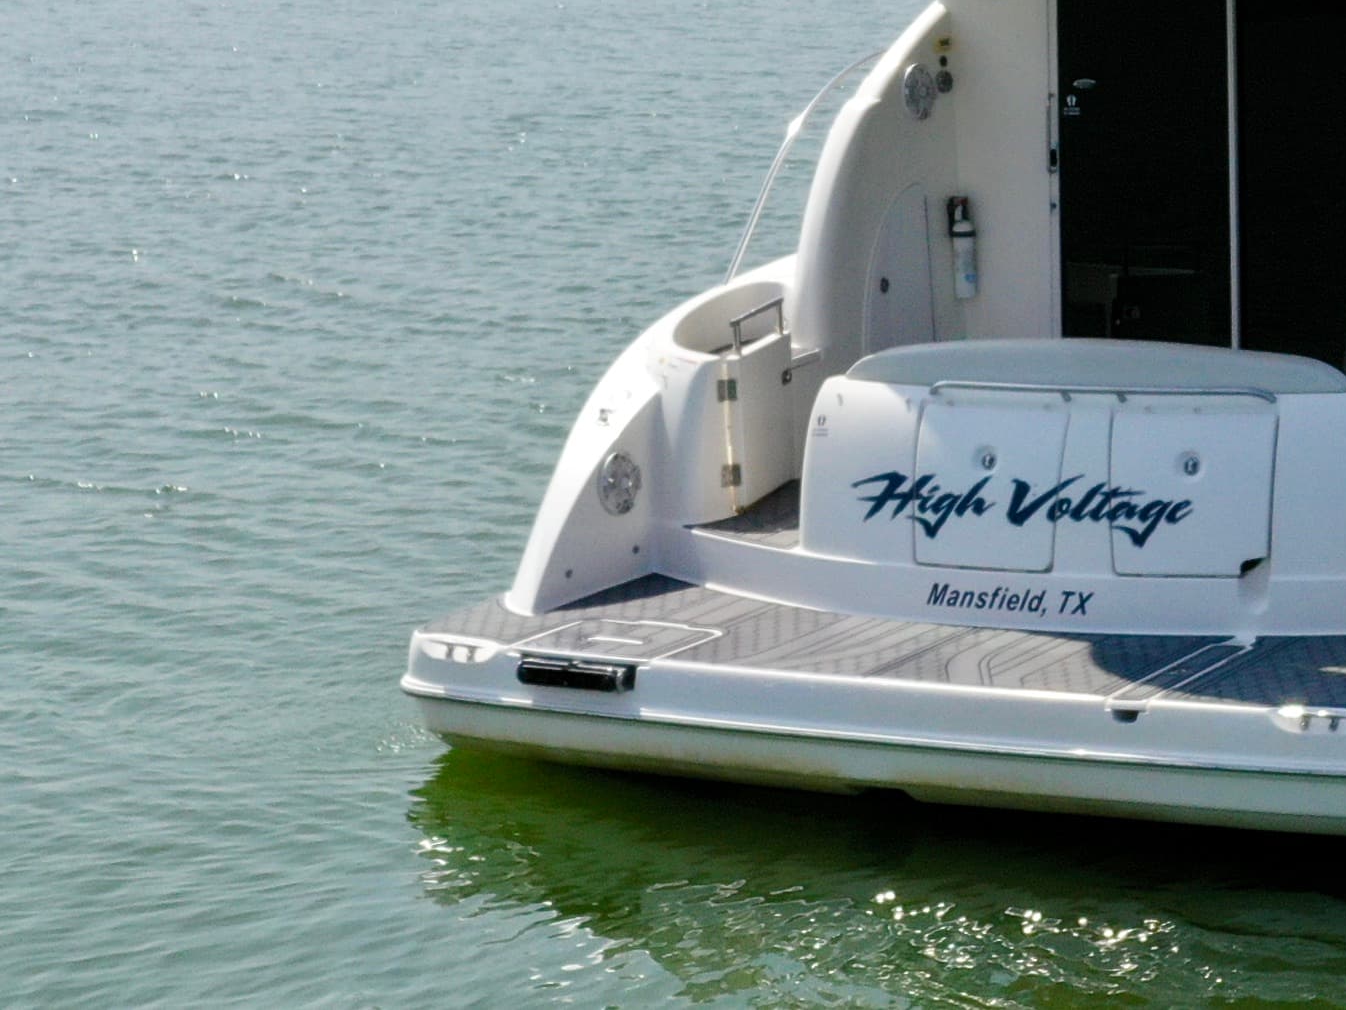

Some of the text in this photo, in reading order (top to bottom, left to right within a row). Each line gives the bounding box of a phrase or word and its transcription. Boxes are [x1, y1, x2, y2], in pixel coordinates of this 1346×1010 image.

[851, 470, 1193, 548] High Voltage
[926, 582, 1095, 618] Mansfield, TX
